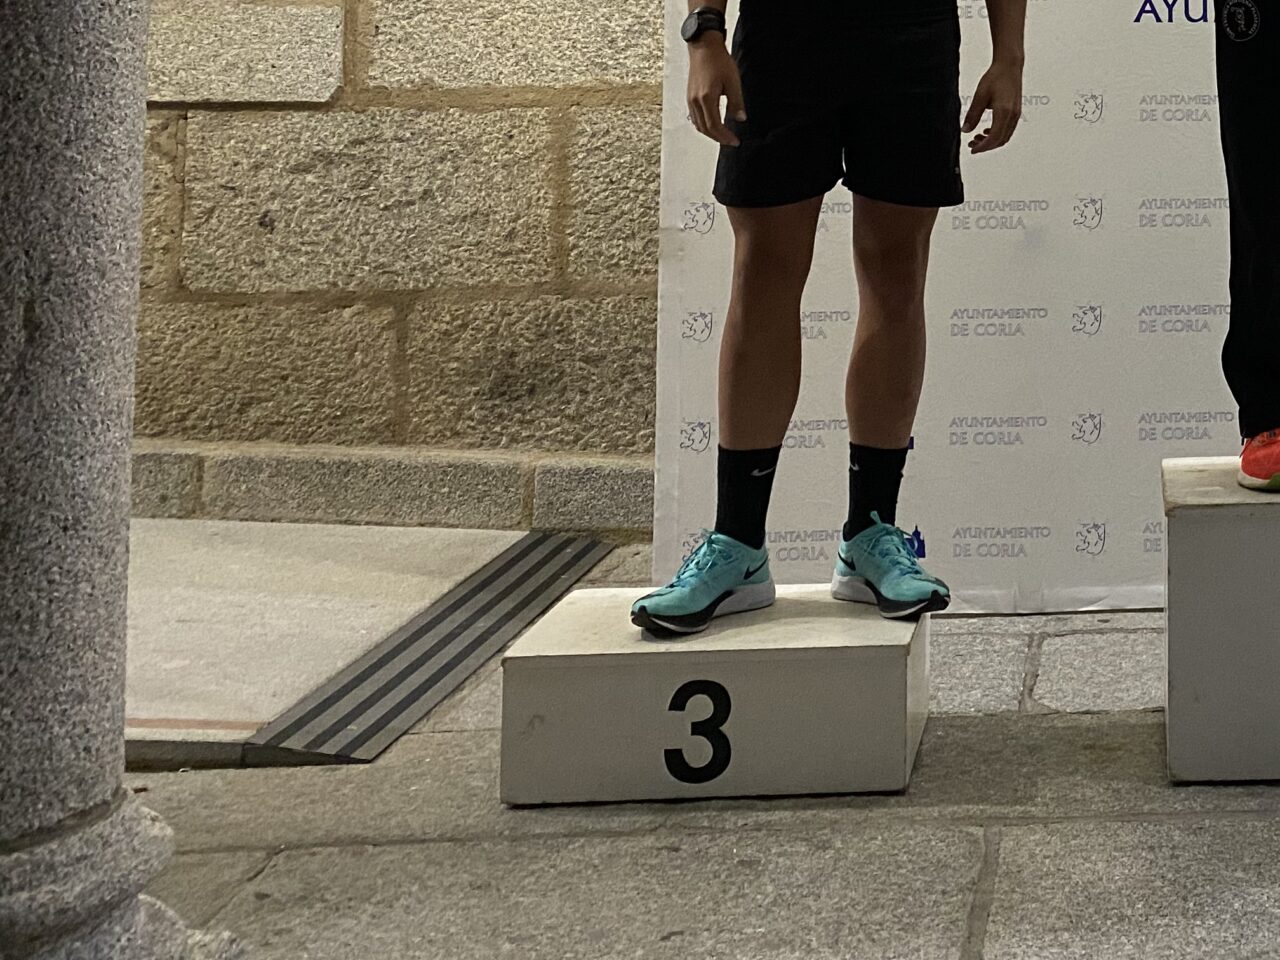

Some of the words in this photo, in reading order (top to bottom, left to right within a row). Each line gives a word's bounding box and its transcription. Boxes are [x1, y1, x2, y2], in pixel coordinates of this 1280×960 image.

[1140, 109, 1158, 122] DE
[1162, 109, 1211, 122] CORIA
[952, 217, 972, 230] DE
[974, 216, 1026, 230] CORIA
[1139, 214, 1158, 227] DE
[1162, 213, 1211, 227] CORIA
[950, 307, 1048, 320] AYUNTAMIENTO
[950, 323, 969, 337] DE
[973, 323, 1025, 337] CORIA
[1139, 320, 1157, 333] DE
[1161, 320, 1211, 333] CORIA
[949, 416, 1047, 428] AYUNTAMIENTO
[1139, 411, 1235, 423] AYUNTAMIENTO
[950, 432, 969, 445] DE
[972, 431, 1024, 445] CORIA
[1139, 427, 1157, 441] DE
[1161, 427, 1213, 441] CORIA
[952, 527, 1052, 539] AYUNTAMIENTO
[776, 546, 829, 561] CORIA
[953, 543, 972, 558] DE
[976, 543, 1028, 558] CORIA
[663, 679, 732, 784] 3
